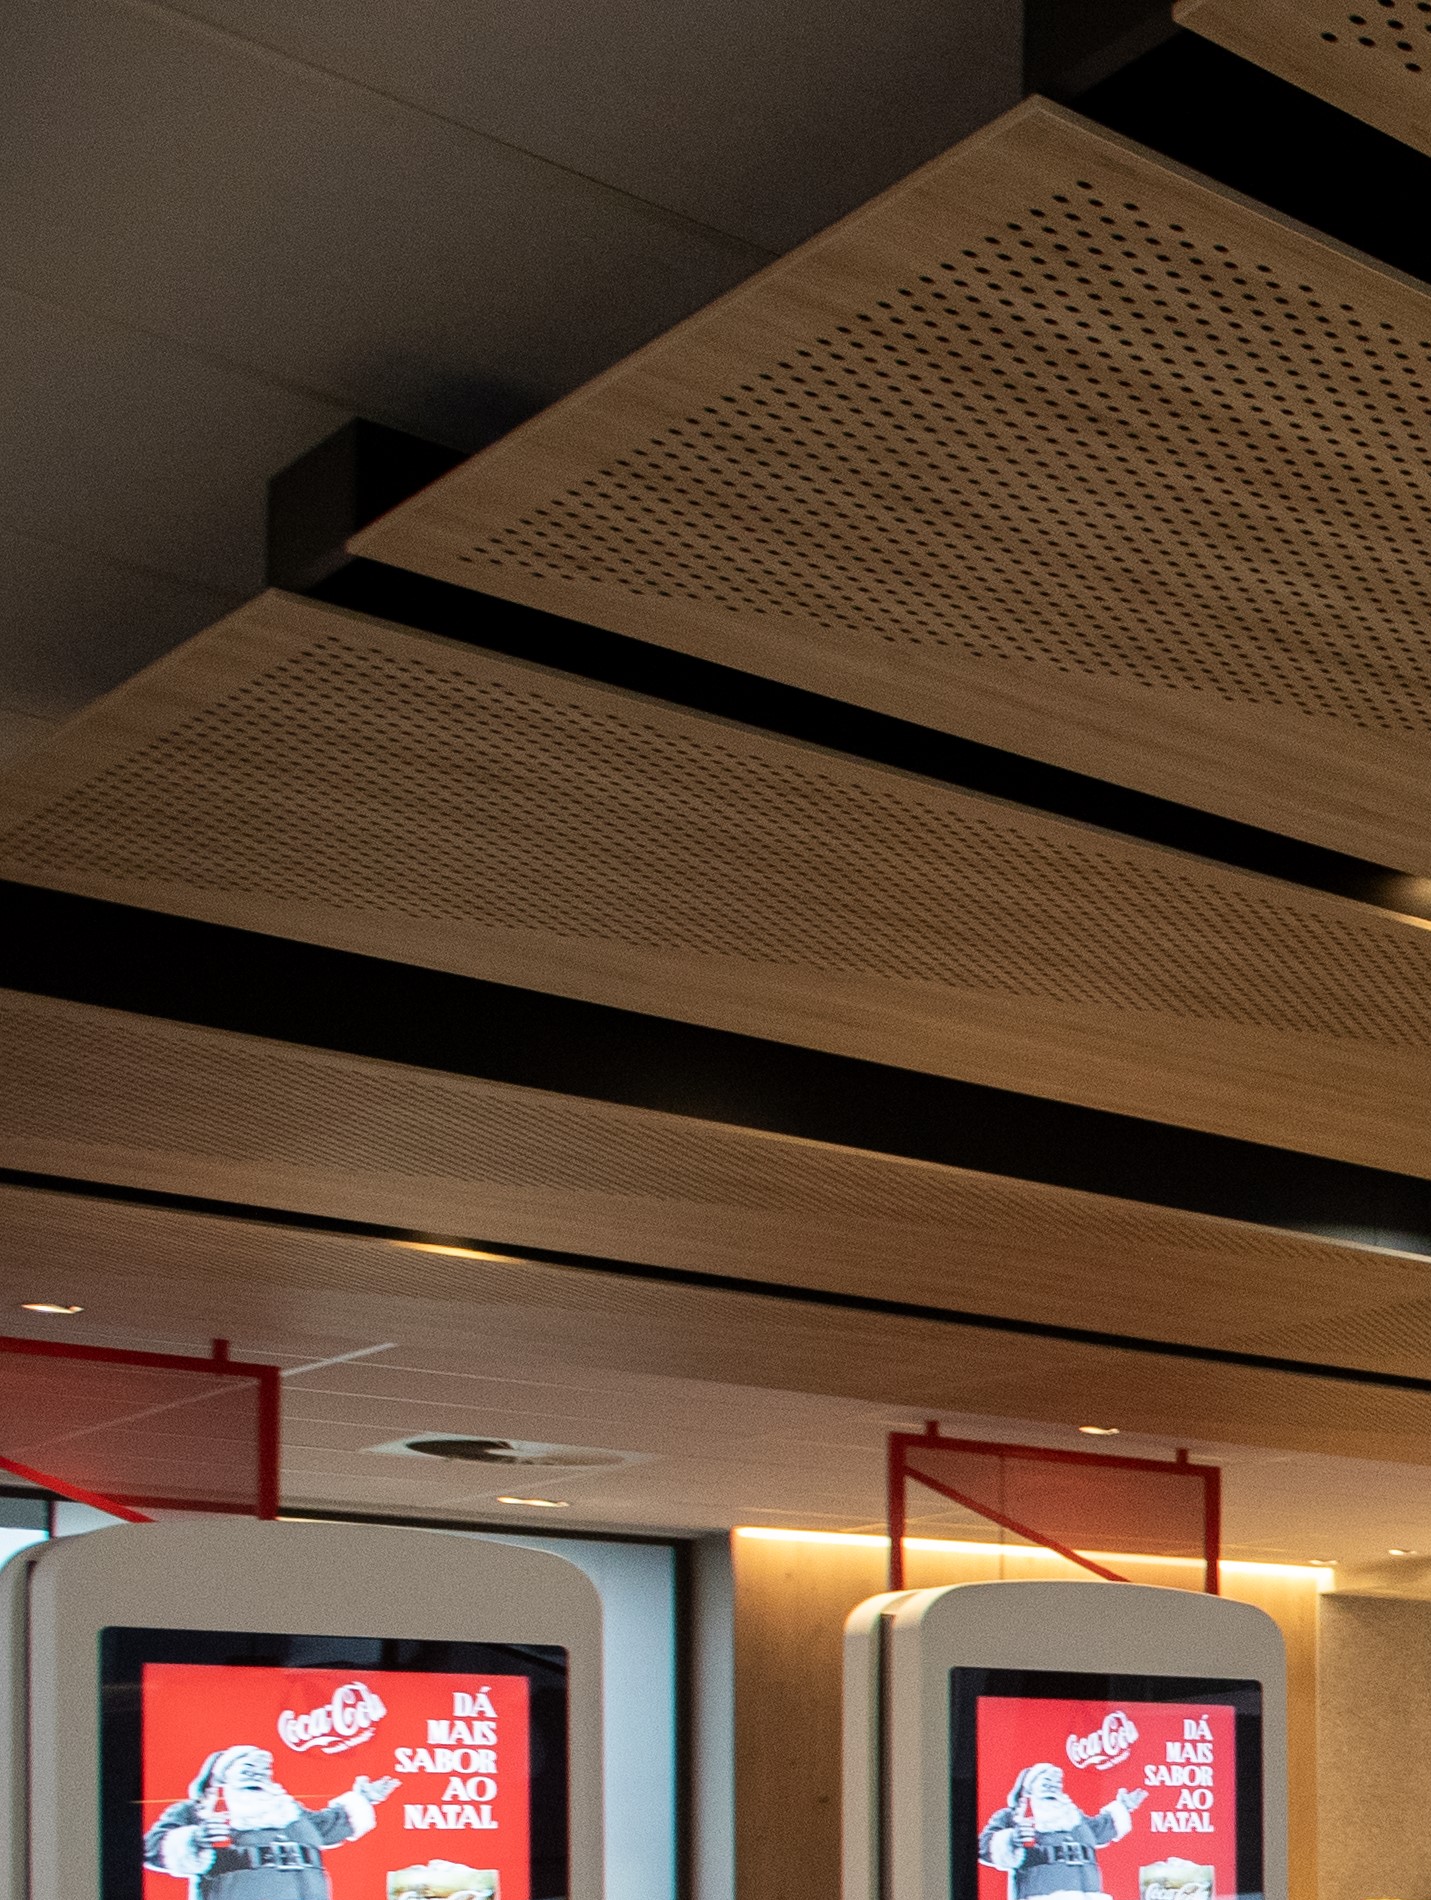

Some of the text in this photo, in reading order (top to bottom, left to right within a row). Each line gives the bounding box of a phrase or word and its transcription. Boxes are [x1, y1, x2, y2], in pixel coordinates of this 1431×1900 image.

[452, 1685, 499, 1718] DÁ
[426, 1719, 498, 1746] MAIS
[1183, 1714, 1214, 1740] DÁ
[394, 1747, 499, 1774] SABOR
[1165, 1741, 1214, 1763] MAIS
[1144, 1764, 1214, 1787] SABOR
[441, 1776, 498, 1802] AO
[1175, 1788, 1214, 1810] AO
[403, 1803, 499, 1830] NATAL
[1150, 1811, 1215, 1833] NATAL
